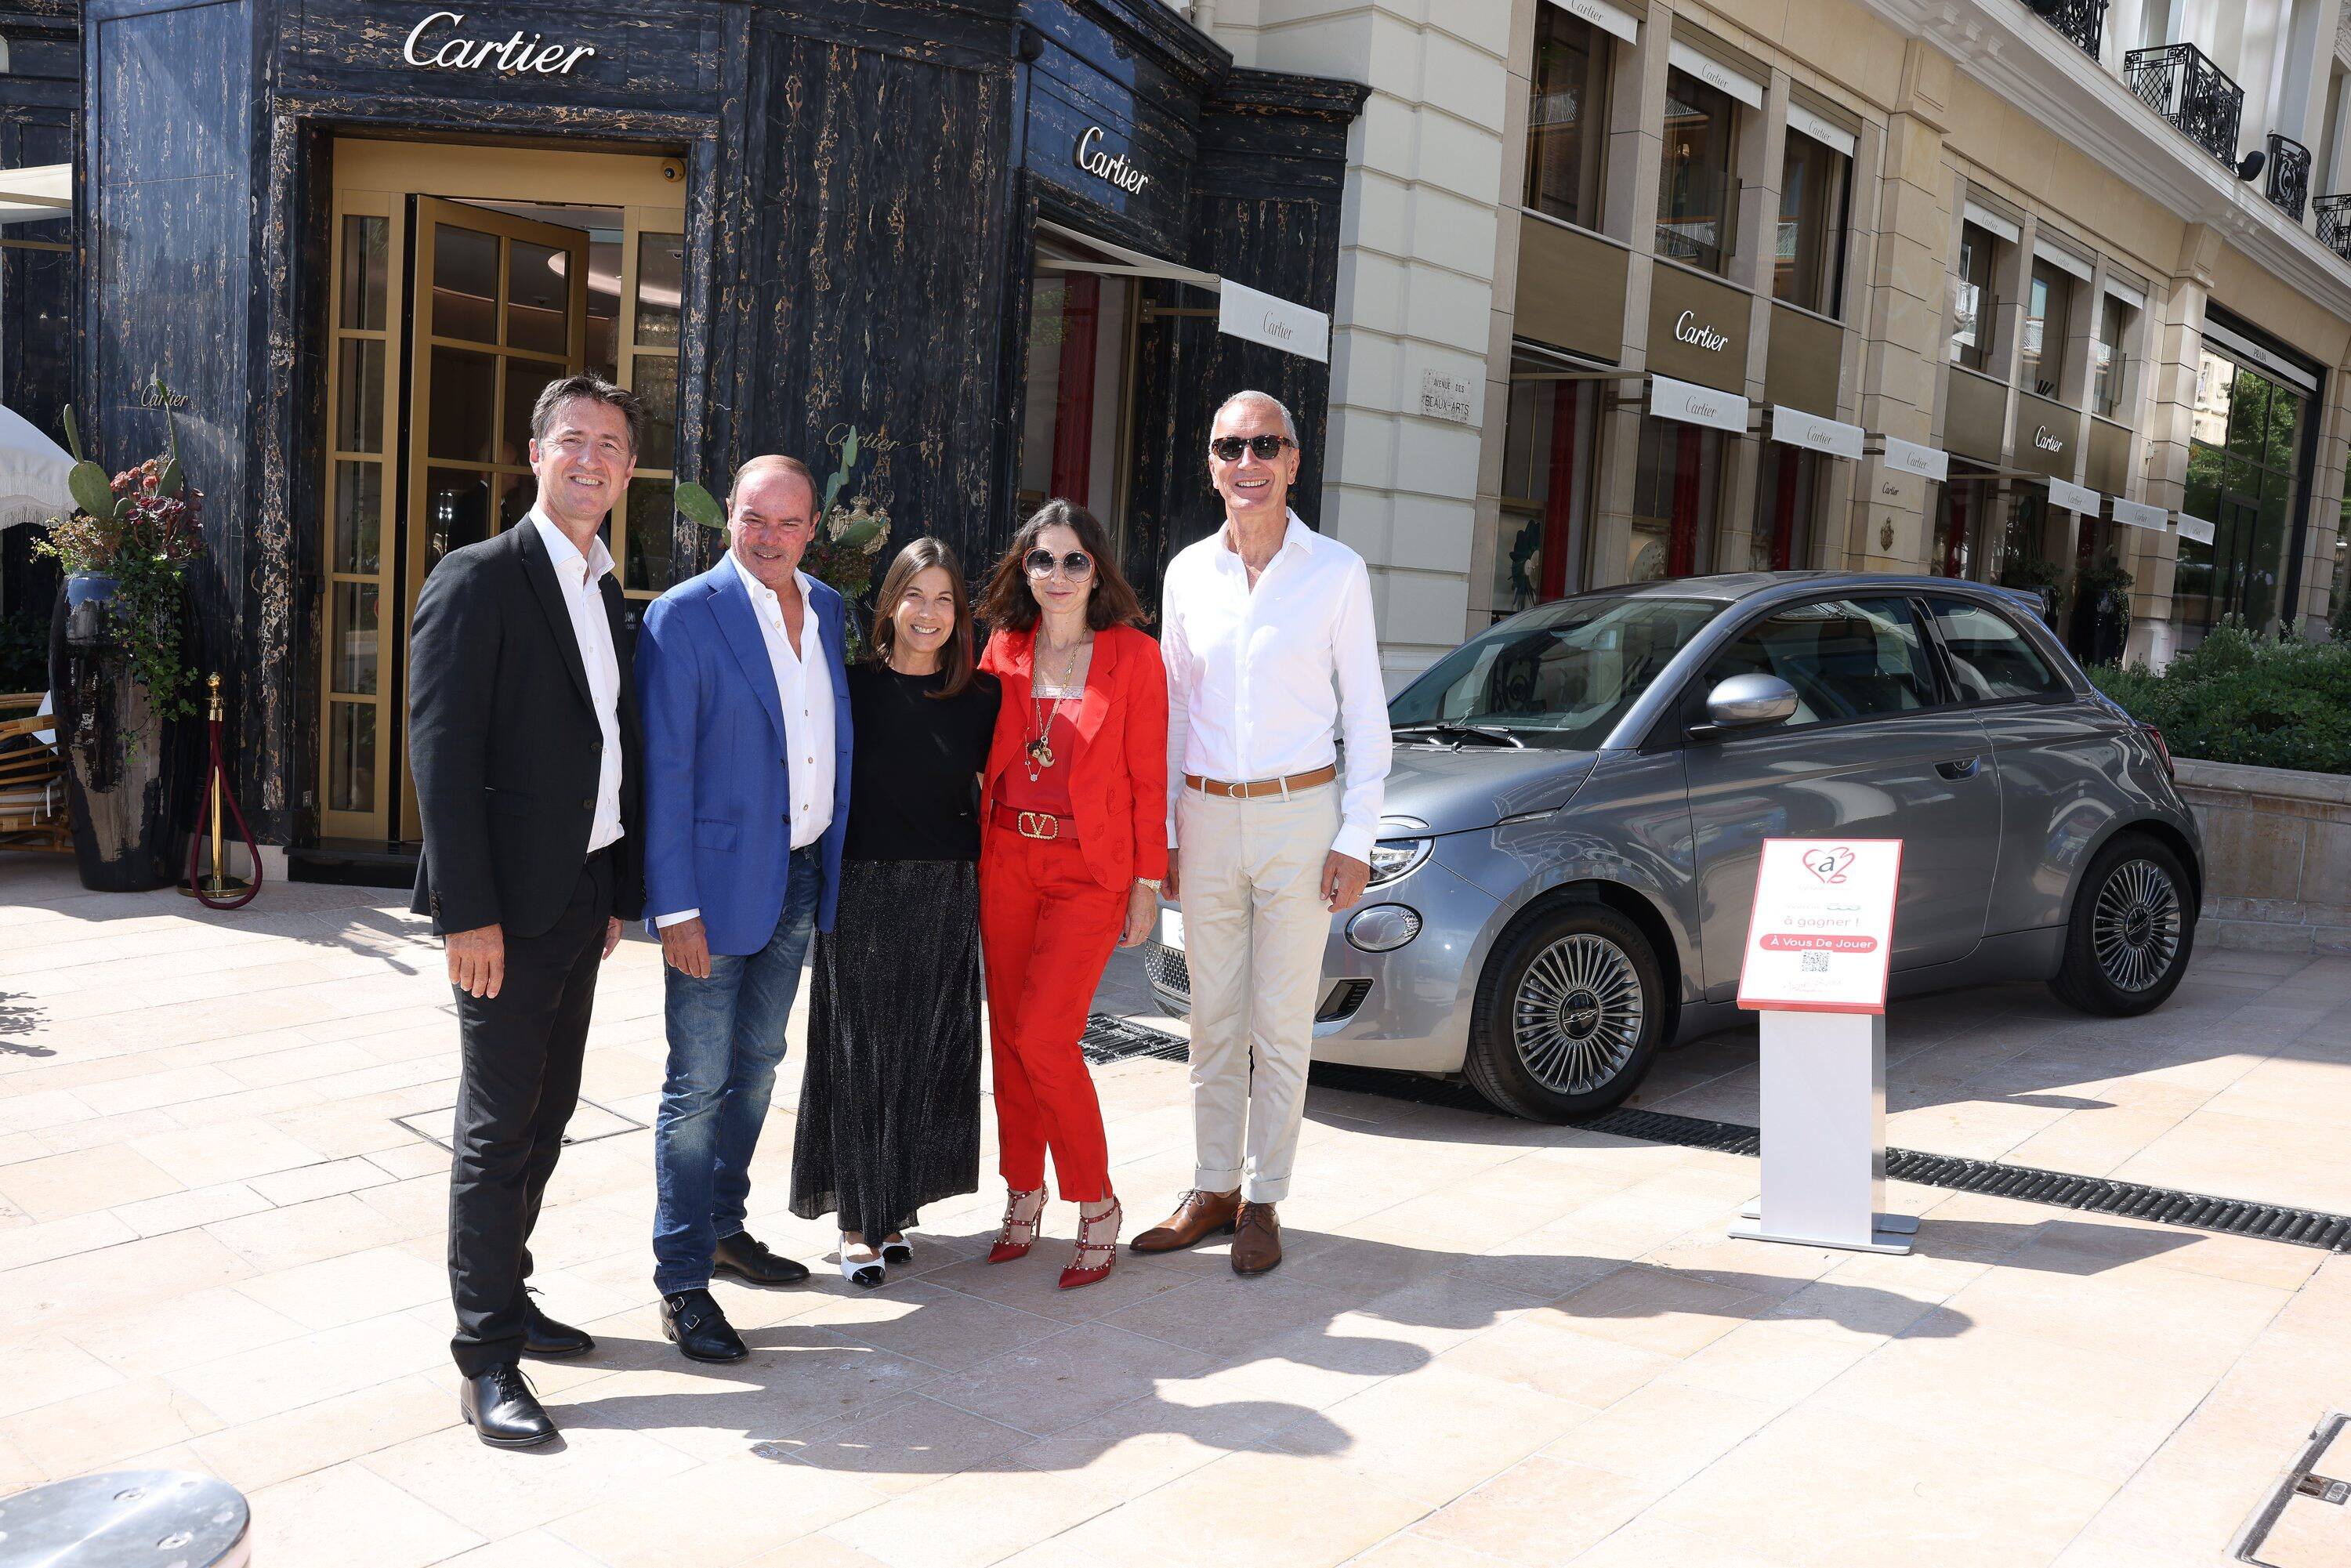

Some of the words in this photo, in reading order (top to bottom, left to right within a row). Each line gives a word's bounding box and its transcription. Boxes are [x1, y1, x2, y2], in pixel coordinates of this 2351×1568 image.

[404, 12, 595, 74] Cartier
[1702, 63, 1729, 89] Cartier
[1809, 120, 1831, 142] Cartier
[1079, 126, 1148, 194] Cartier
[1263, 308, 1293, 340] Cartier
[1675, 310, 1728, 352] Cartier
[1433, 378, 1451, 389] AVENUE
[1455, 384, 1465, 393] DES
[1425, 395, 1469, 415] BEAUX-ARTS
[1686, 395, 1717, 418] Cartier
[1806, 425, 1832, 445] Cartier
[2035, 425, 2063, 453] Cartier
[1907, 451, 1928, 469] Cartier
[1882, 481, 1900, 496] Cartier
[1818, 856, 1835, 872] a
[1784, 915, 1793, 925] à
[1797, 918, 1851, 929] gagner
[1770, 935, 1780, 946] À
[1783, 938, 1813, 947] Vous
[1816, 939, 1832, 947] De
[1835, 940, 1875, 948] Jouer
